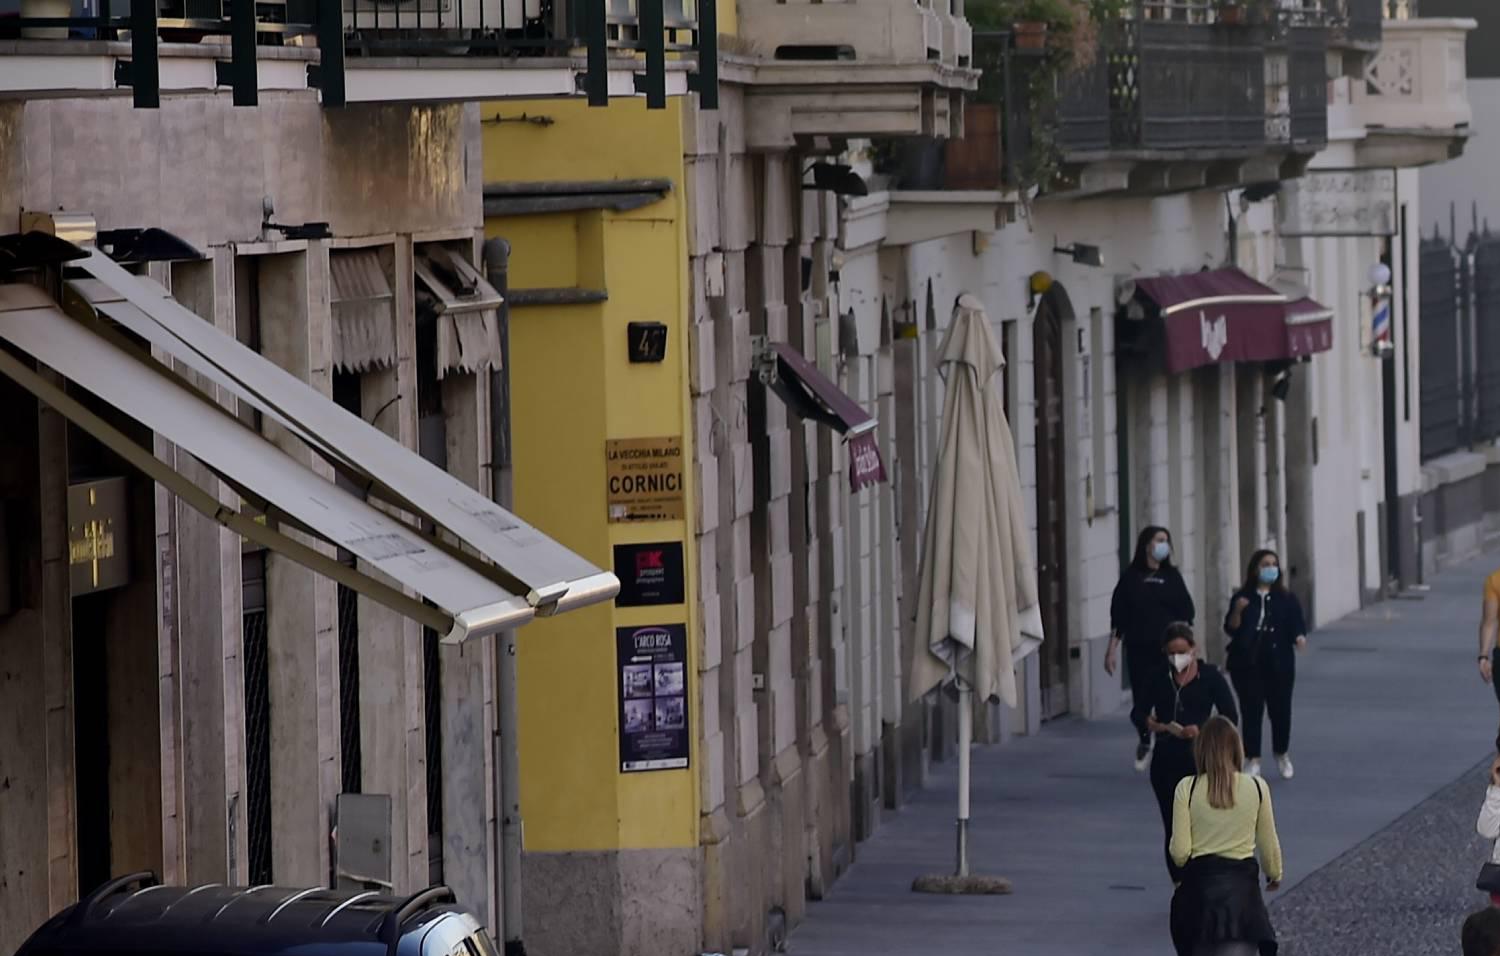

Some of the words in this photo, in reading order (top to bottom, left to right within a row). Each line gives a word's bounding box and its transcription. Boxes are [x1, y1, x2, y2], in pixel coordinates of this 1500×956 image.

[608, 450, 618, 460] LA
[652, 447, 681, 457] MILANO
[609, 472, 683, 494] CORNICI
